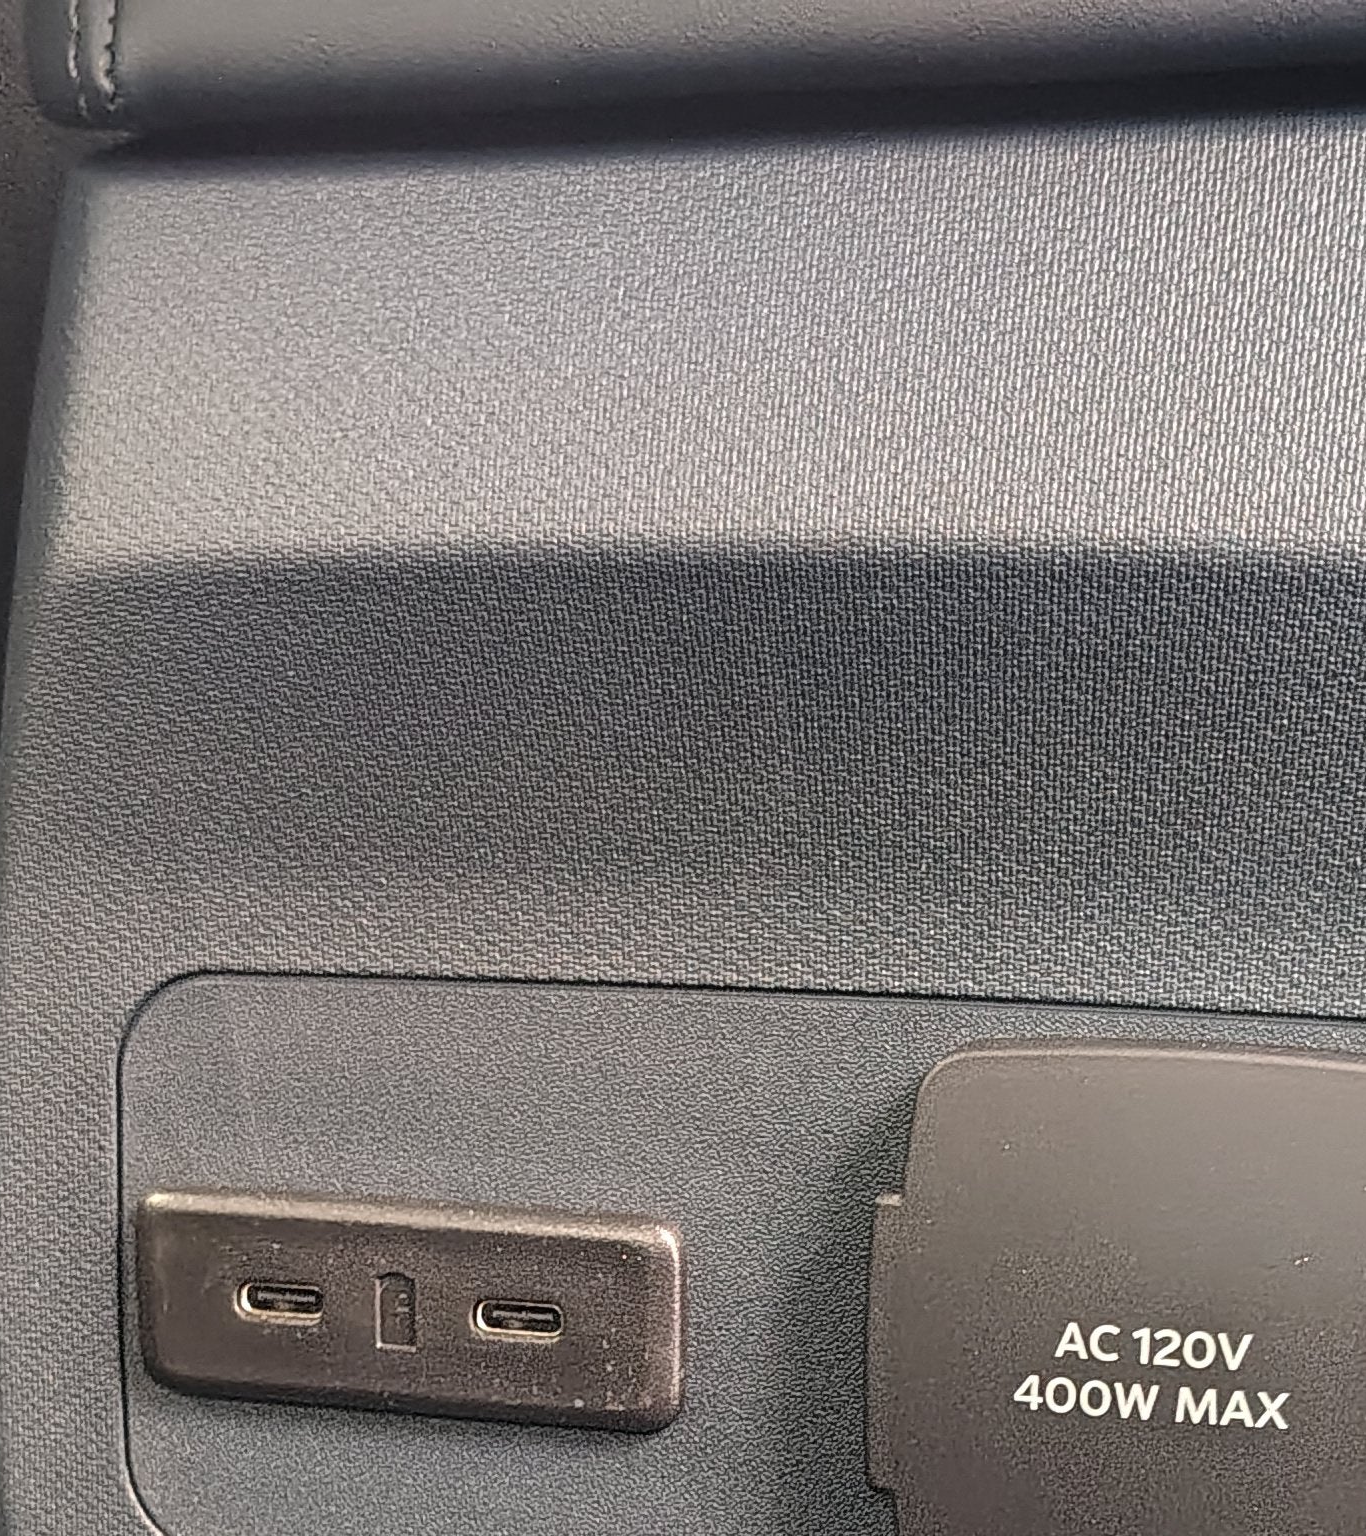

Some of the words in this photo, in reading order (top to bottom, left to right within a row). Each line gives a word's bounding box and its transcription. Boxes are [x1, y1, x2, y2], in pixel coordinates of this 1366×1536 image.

[1054, 1321, 1121, 1362] AC
[1131, 1326, 1255, 1371] 120V
[1013, 1374, 1160, 1421] 400W
[1174, 1386, 1292, 1430] MAX
